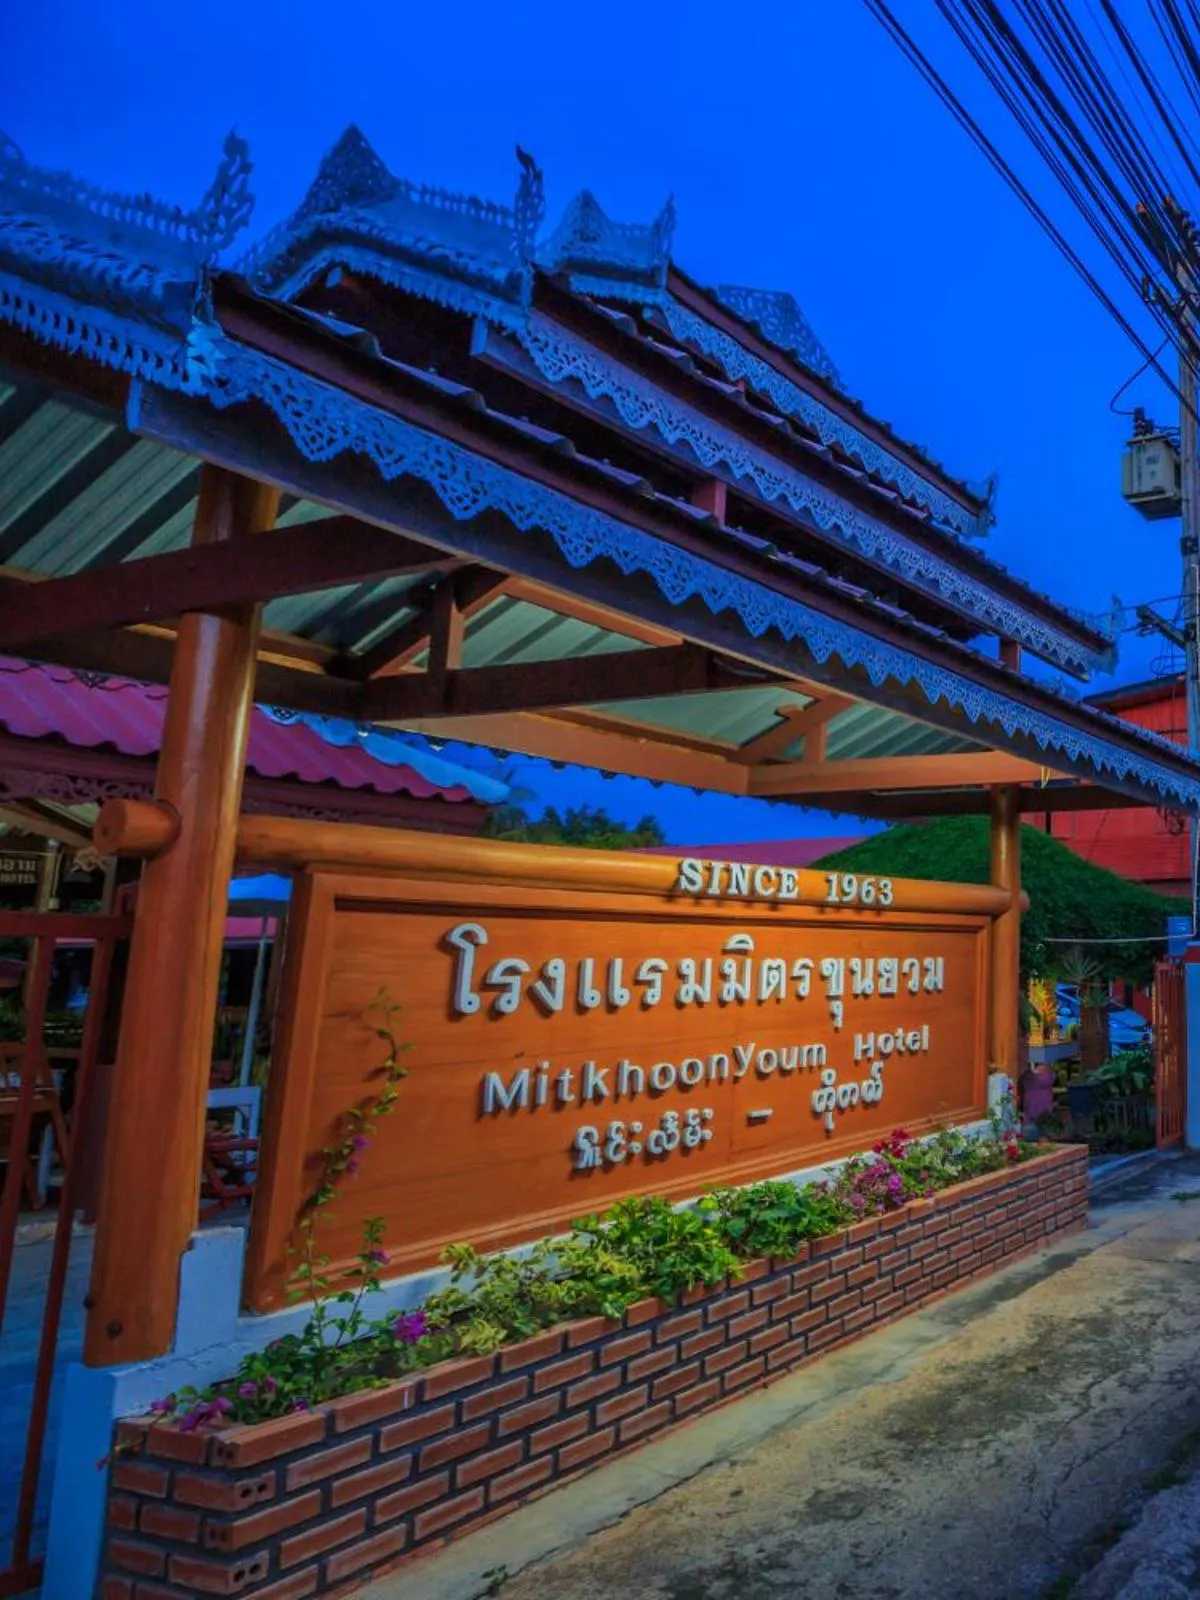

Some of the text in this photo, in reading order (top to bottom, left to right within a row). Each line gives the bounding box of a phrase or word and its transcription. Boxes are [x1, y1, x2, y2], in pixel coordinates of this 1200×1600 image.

[680, 857, 893, 905] SINCE 1963
[447, 922, 944, 1029] โรงแรมมิตรขุนยวม
[854, 1024, 930, 1060] Hotel
